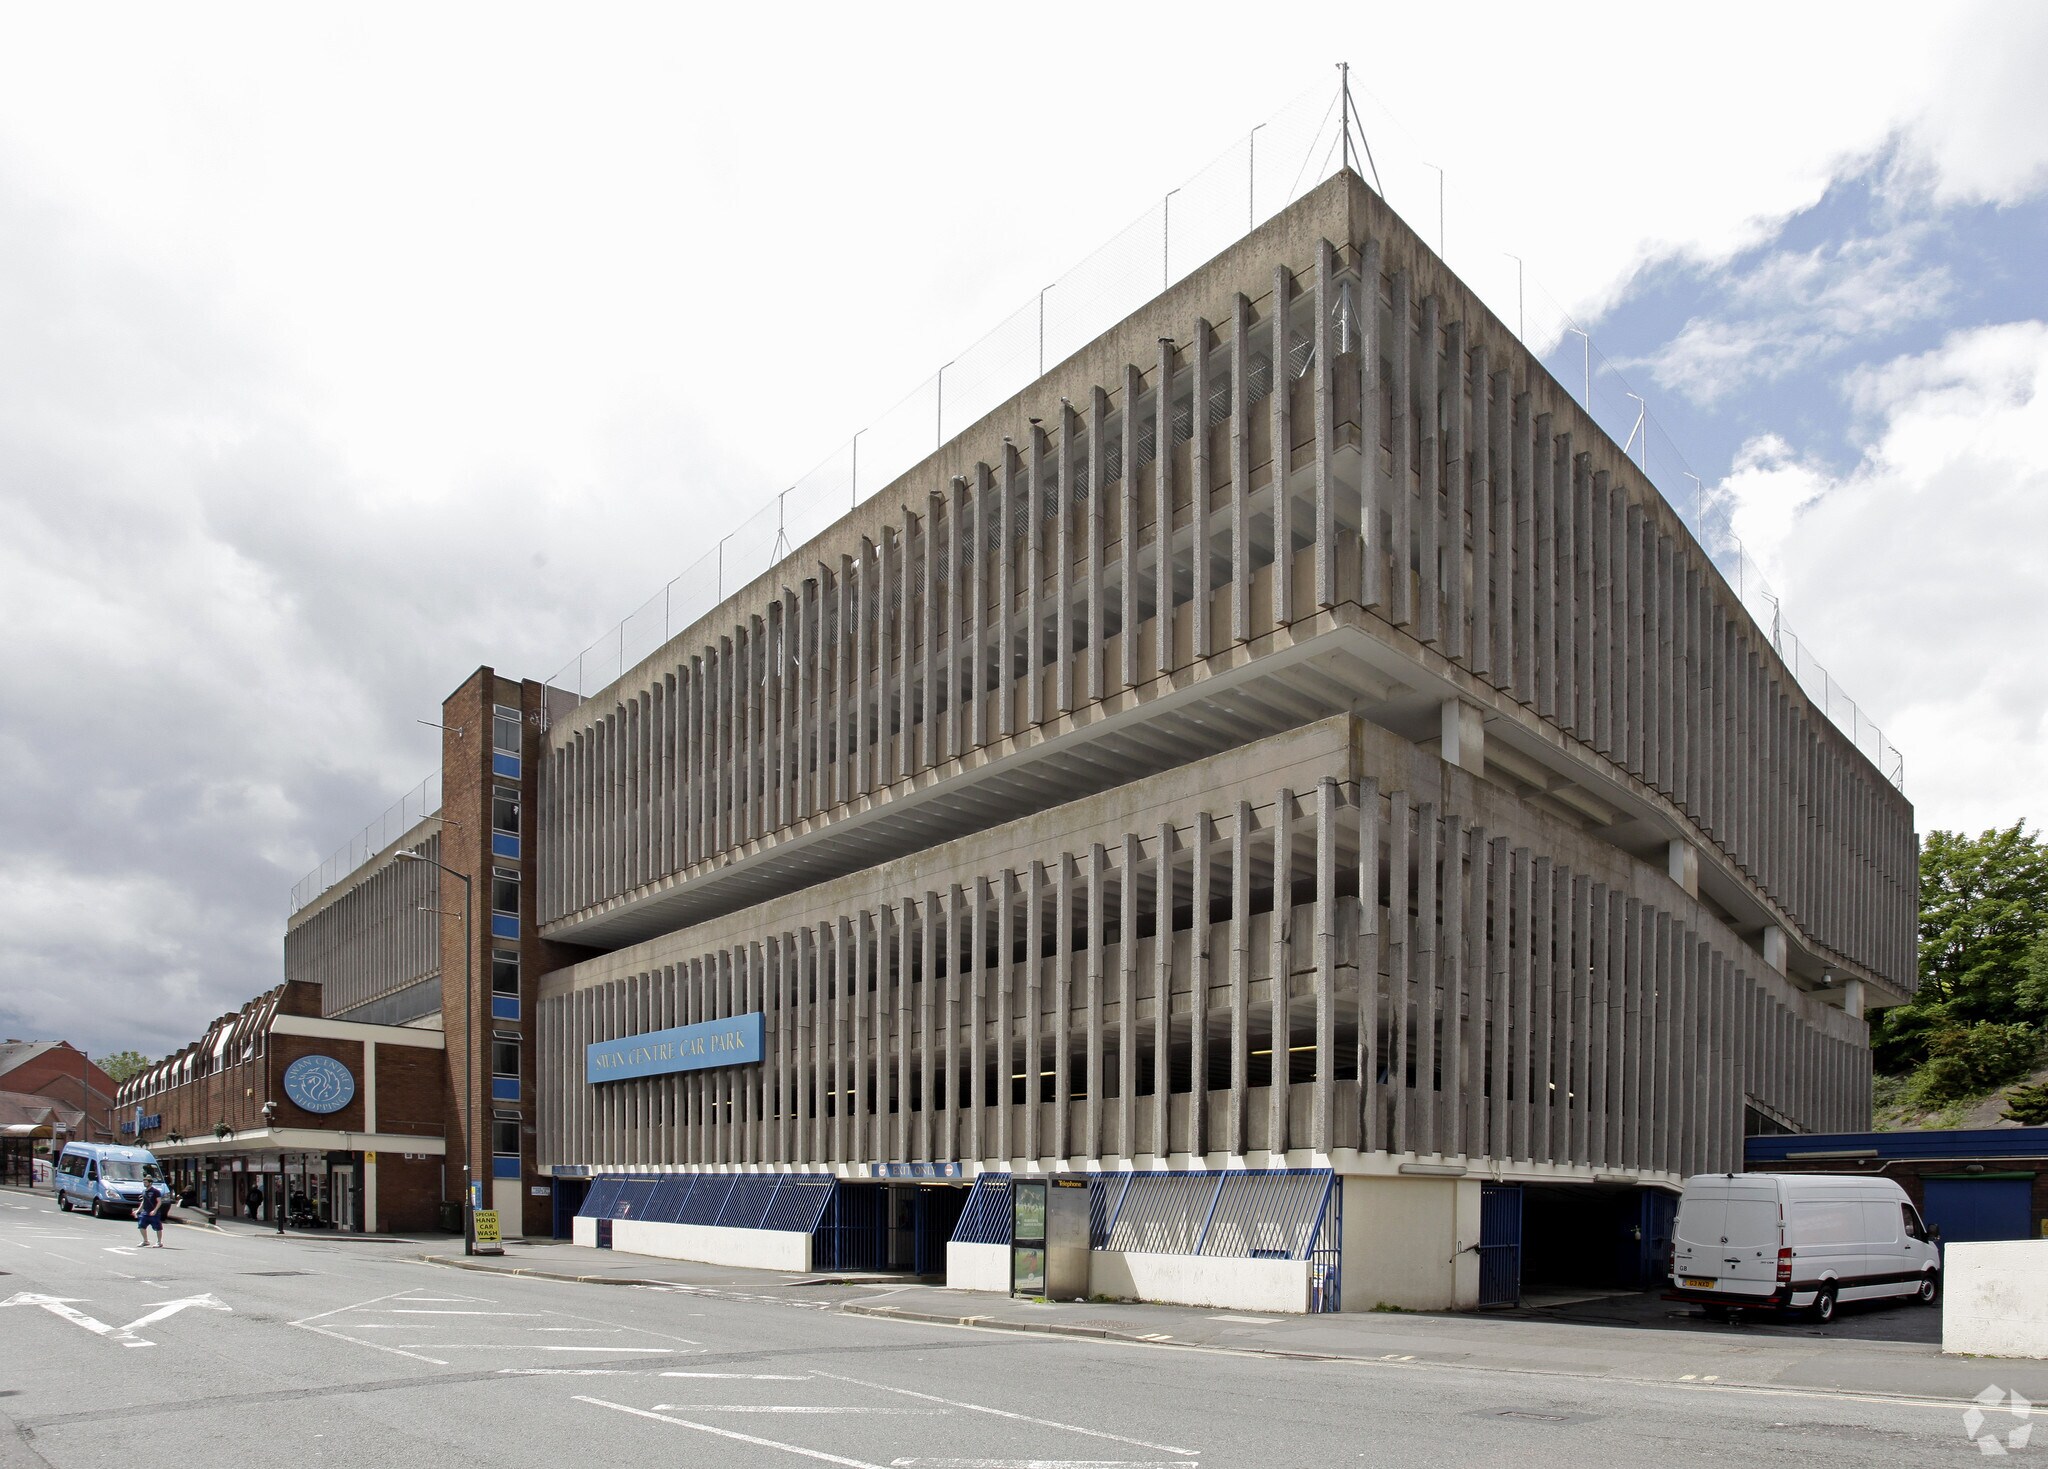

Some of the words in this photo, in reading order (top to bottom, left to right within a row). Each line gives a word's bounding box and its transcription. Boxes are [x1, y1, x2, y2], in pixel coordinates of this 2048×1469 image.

[596, 1050, 625, 1071] SWAN
[628, 1040, 677, 1065] CENTRE
[680, 1036, 705, 1057] CAR
[711, 1030, 745, 1053] PARK
[289, 1059, 312, 1079] SWAN
[315, 1058, 350, 1082] CENTRE
[294, 1093, 347, 1111] SHOPPING
[892, 1165, 911, 1175] EXIT
[914, 1165, 937, 1175] ONLY
[1058, 1180, 1082, 1188] Telephone
